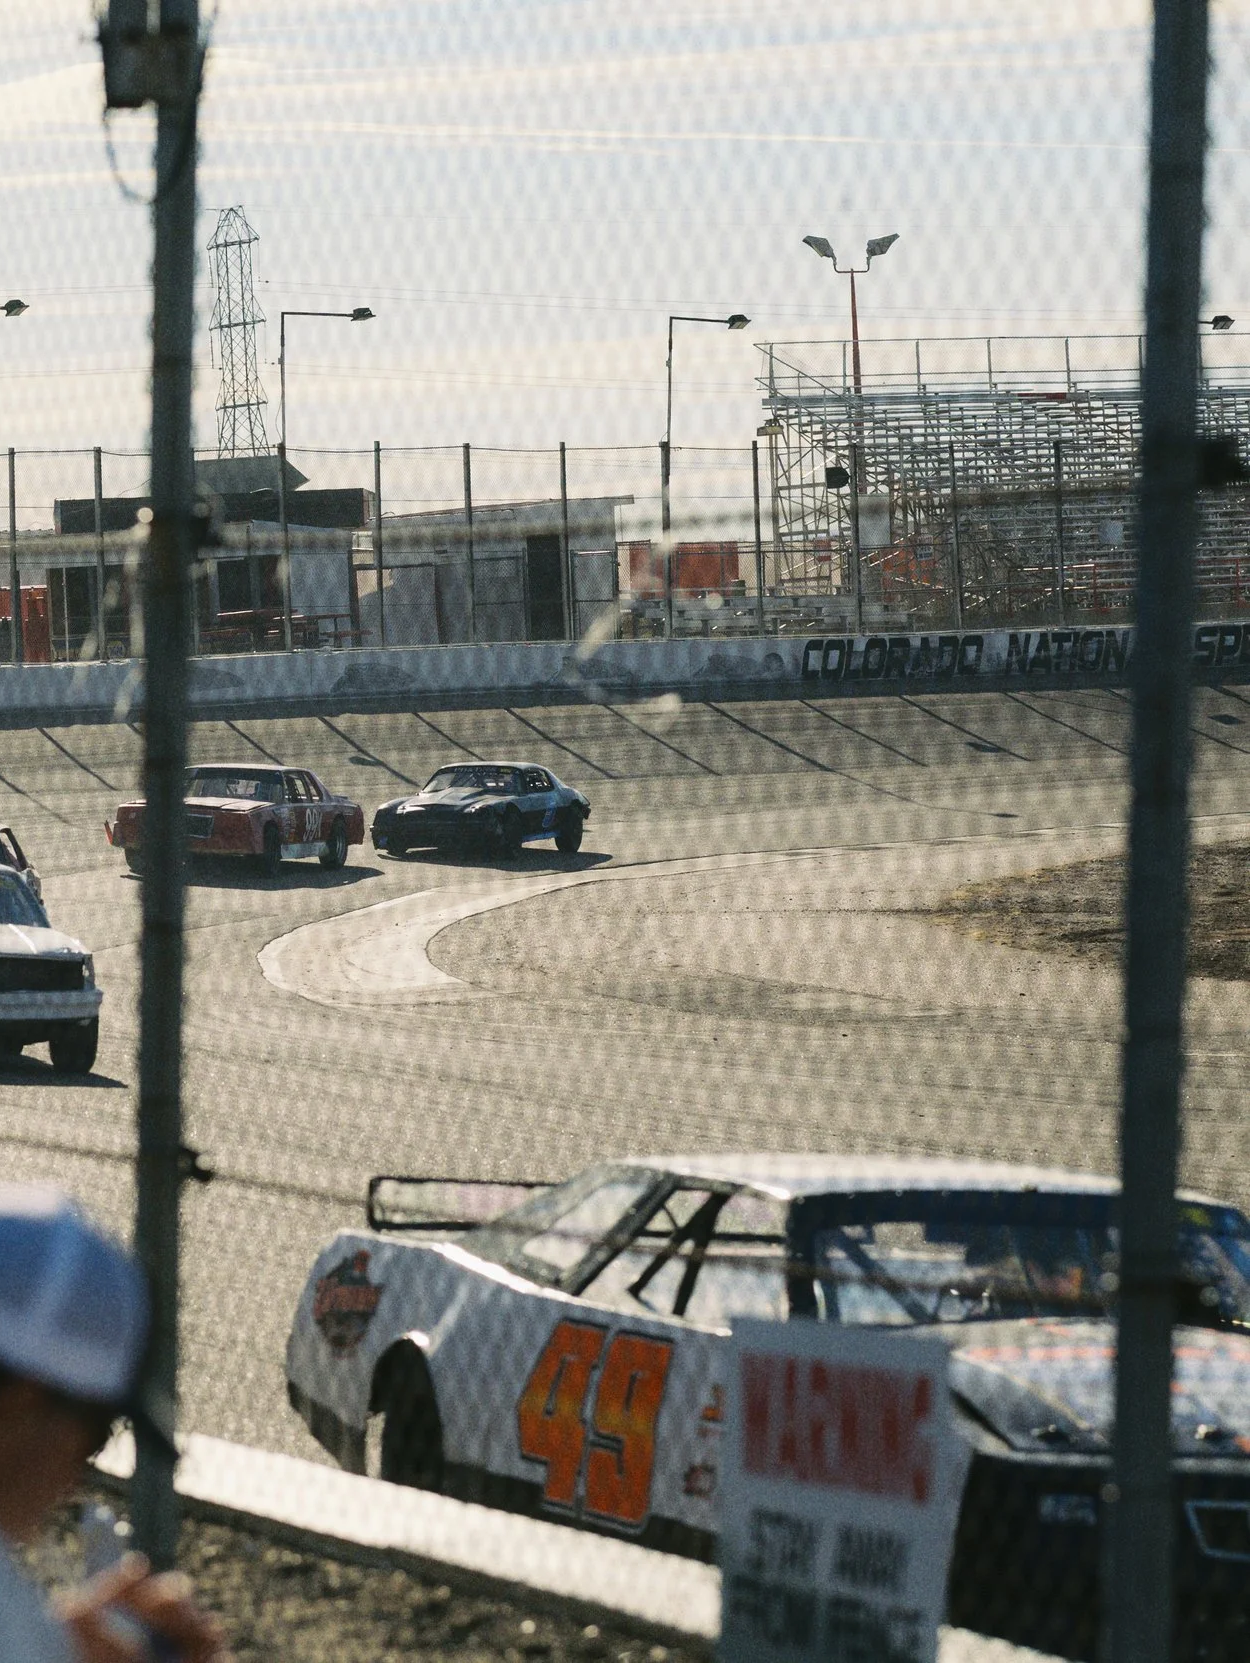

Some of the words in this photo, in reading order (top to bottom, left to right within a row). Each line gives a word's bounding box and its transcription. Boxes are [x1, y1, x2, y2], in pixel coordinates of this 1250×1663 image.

[802, 633, 984, 680] COLORADO
[1006, 628, 1134, 674] NATION
[516, 1316, 676, 1534] 49
